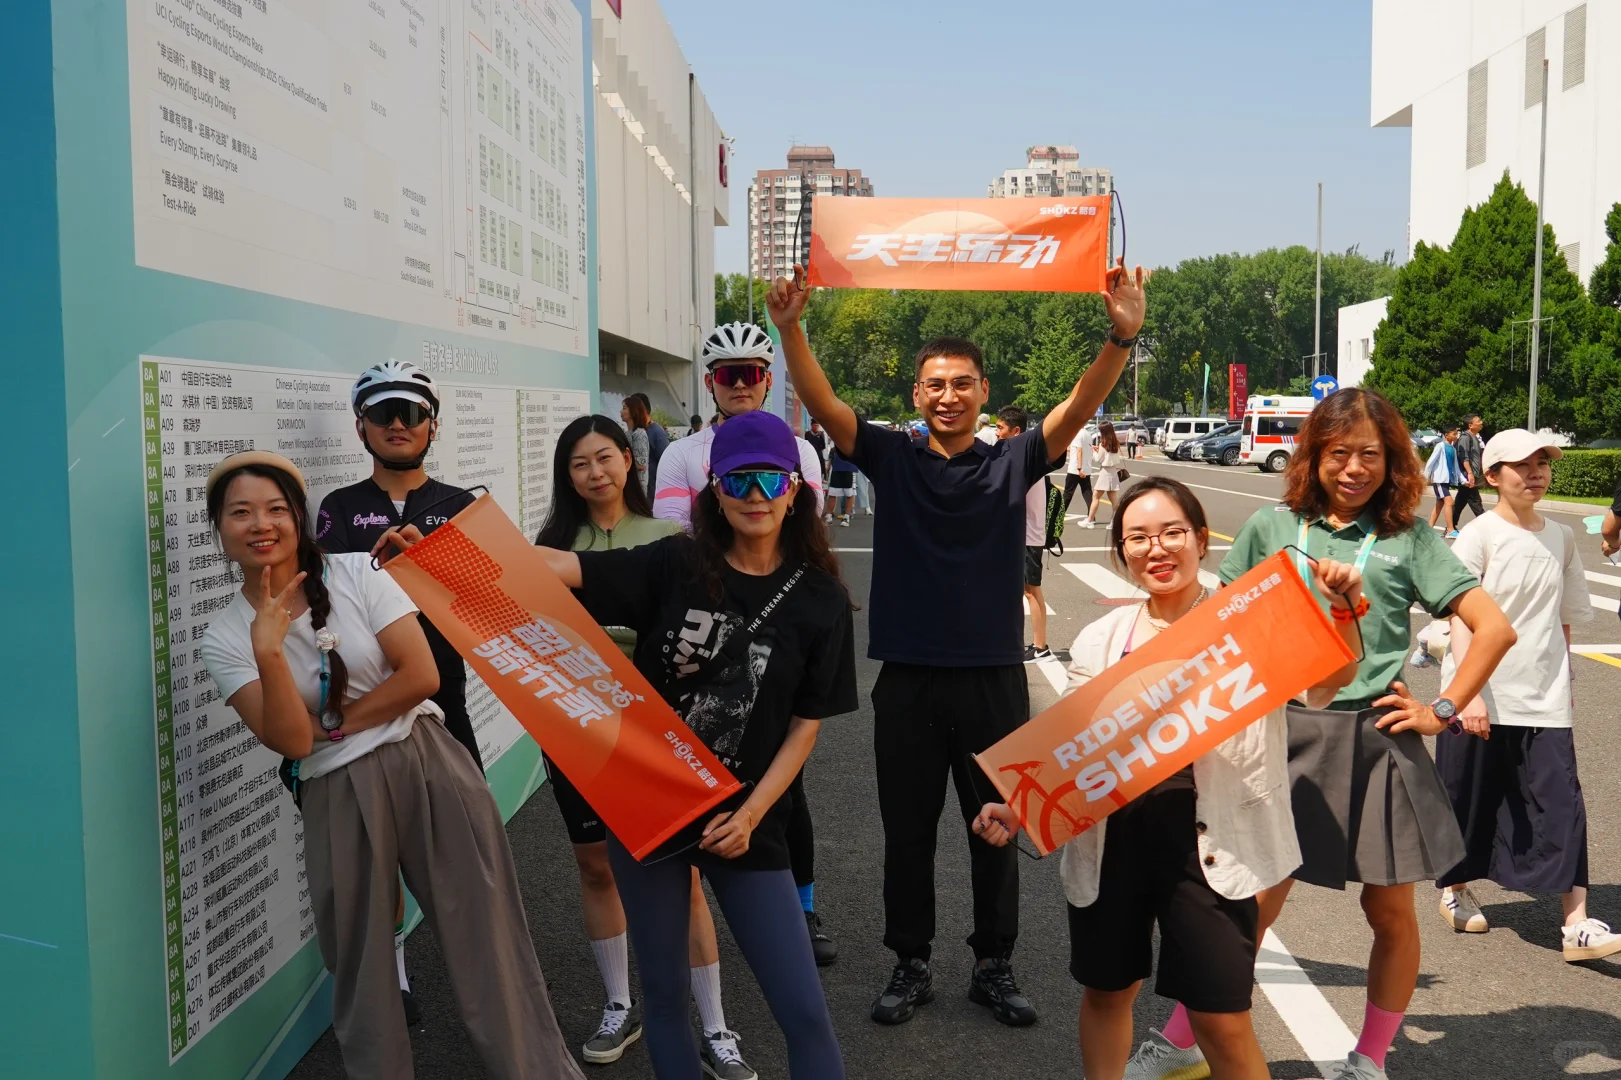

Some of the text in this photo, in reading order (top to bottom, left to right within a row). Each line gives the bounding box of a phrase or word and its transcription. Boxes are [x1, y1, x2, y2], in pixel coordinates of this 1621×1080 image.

[156, 2, 168, 20] UCI
[168, 10, 190, 37] Cycling
[190, 23, 212, 46] Esports
[212, 35, 228, 56] World
[158, 66, 236, 120] Happy Riding Lucky Drawing
[160, 130, 238, 173] Every Stamp, Every Surprise
[162, 194, 197, 216] Test-A-Ride
[1040, 205, 1096, 217] SHOKZ 韶音
[846, 232, 1061, 268] 天生乐动
[144, 368, 153, 381] 8A
[160, 370, 172, 383] A01
[454, 348, 487, 374] Exhibitor
[487, 352, 499, 376] List
[276, 379, 292, 390] Chinese
[294, 380, 308, 393] Cycling
[145, 393, 154, 406] 8A
[161, 394, 173, 407] A02
[146, 418, 155, 430] 8A
[162, 418, 174, 431] A09
[147, 442, 156, 454] 8A
[163, 442, 174, 455] A39
[148, 466, 157, 479] 8A
[164, 466, 175, 478] A40
[149, 491, 158, 504] 8A
[165, 490, 176, 502] A78
[150, 515, 159, 528] 8A
[166, 513, 177, 526] A82
[151, 531, 212, 552] 8A A83 天丝集团
[152, 564, 161, 577] 8A
[168, 560, 179, 573] A88
[153, 584, 180, 601] 8A A91
[747, 569, 804, 634] THE DREAM BEGINS
[1217, 572, 1282, 622] SHOKZ 韶音
[154, 612, 164, 625] 8A
[170, 607, 181, 622] A99
[156, 636, 165, 649] 8A
[171, 629, 186, 646] A100
[512, 618, 612, 680] 韶音
[156, 660, 166, 674] 8A
[172, 653, 187, 670] A101
[158, 684, 166, 698] 8A
[173, 676, 188, 693] A102
[472, 634, 614, 728] 骑行家
[159, 708, 168, 721] 8A
[174, 699, 190, 716] A108
[1052, 632, 1242, 771] RIDE WITH
[160, 732, 169, 745] 8A
[175, 722, 190, 740] A109
[1074, 662, 1268, 803] SHOKZ
[160, 756, 170, 770] 8A
[176, 746, 192, 764] A110
[664, 730, 702, 771] SHOKZ
[697, 768, 718, 788] 韶音
[162, 779, 171, 794] 8A
[177, 769, 193, 787] A115
[163, 802, 172, 817] 8A
[178, 791, 194, 810] A116
[164, 826, 173, 841] 8A
[179, 814, 195, 834] A117
[200, 803, 212, 821] Free
[214, 800, 218, 814] U
[219, 791, 238, 810] Nature
[165, 836, 196, 865] 8A A118
[166, 873, 175, 888] 8A
[182, 859, 197, 880] A221
[167, 896, 176, 912] 8A
[182, 883, 198, 903] A229
[168, 904, 199, 935] 8A A234
[169, 942, 178, 958] 8A
[184, 926, 200, 949] A246
[170, 965, 179, 982] 8A
[185, 949, 201, 972] A267
[171, 988, 180, 1005] 8A
[186, 972, 202, 996] A271
[172, 1012, 181, 1029] 8A
[187, 994, 204, 1017] A276
[173, 1034, 182, 1052] 8A
[188, 1019, 200, 1040] D01
